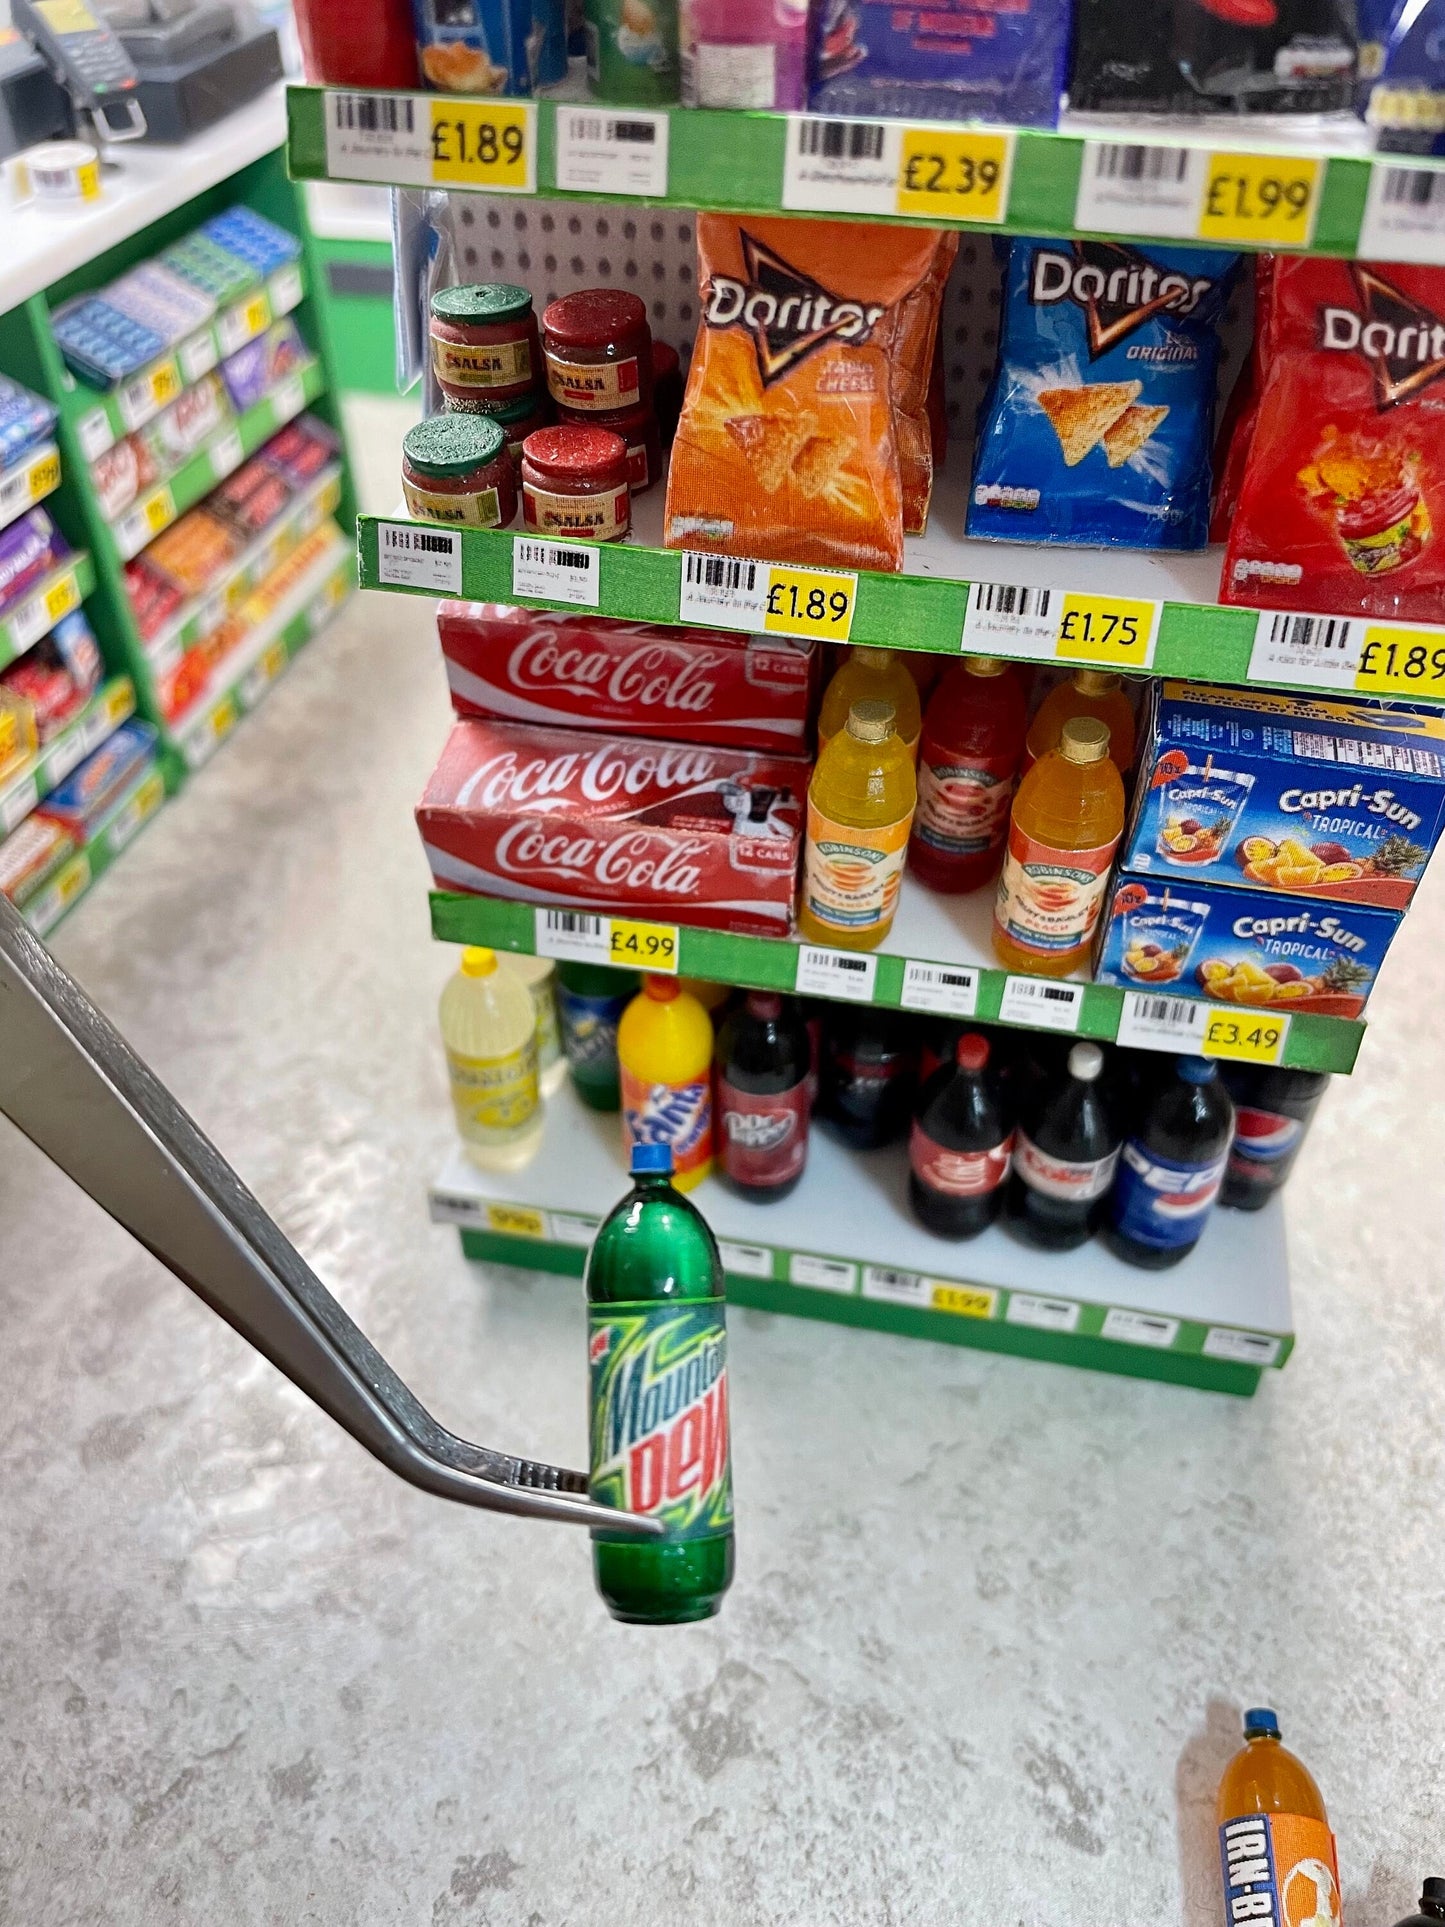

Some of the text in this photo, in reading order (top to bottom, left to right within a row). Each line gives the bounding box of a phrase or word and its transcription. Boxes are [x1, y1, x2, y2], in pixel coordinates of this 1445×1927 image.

[430, 120, 524, 164] £1.89
[904, 154, 999, 196] £2.39
[1206, 176, 1312, 220] £1.99
[1033, 252, 1212, 314] Doritos
[707, 277, 885, 340] Doritos
[453, 356, 503, 371] SALSA
[557, 374, 606, 391] SALSA
[551, 511, 605, 527] SALSA
[766, 583, 848, 622] £1.89
[1060, 610, 1138, 646] £1.75
[507, 630, 728, 712] Coca-Cola
[1358, 641, 1445, 680] £1.89
[1182, 689, 1235, 701] PLEASE
[1286, 703, 1329, 714] FROM
[1214, 698, 1263, 710] FRONT
[1292, 709, 1320, 718] THE
[1326, 714, 1357, 724] BOX
[1168, 786, 1237, 809] Capri-Sun
[1278, 783, 1423, 831] Capri-Sun
[1312, 813, 1382, 840] TROPICAL
[495, 818, 713, 895] Coca-Cola
[756, 849, 789, 863] CANS
[818, 843, 884, 862] ROBINSONS
[1024, 865, 1095, 885] ROBINSONS
[1024, 918, 1069, 932] PEACH
[1232, 912, 1367, 953] Capri-Sun
[611, 931, 675, 957] £4.99
[1263, 938, 1330, 960] TROPICAL
[1207, 1021, 1280, 1049] £3.49
